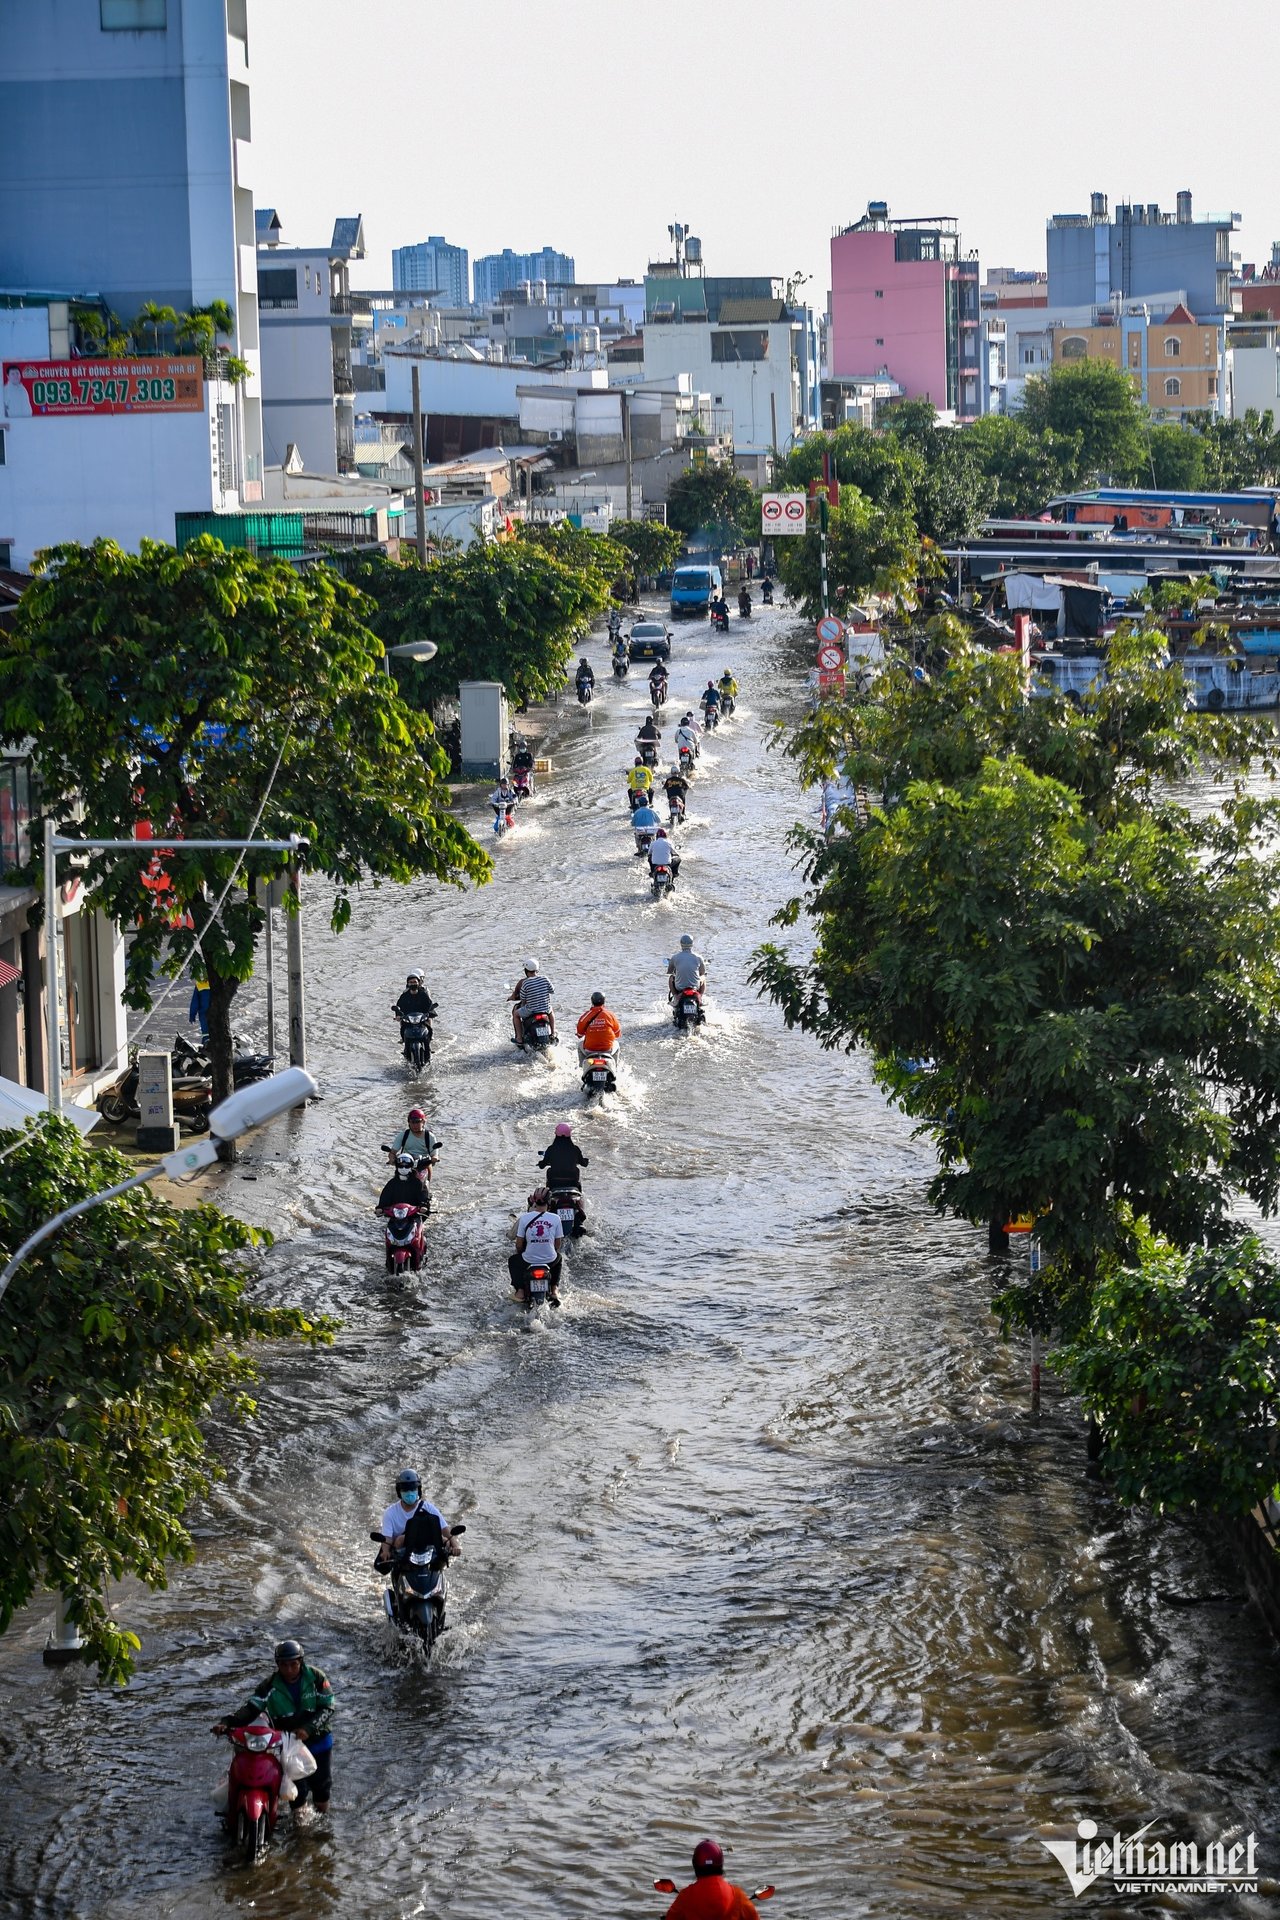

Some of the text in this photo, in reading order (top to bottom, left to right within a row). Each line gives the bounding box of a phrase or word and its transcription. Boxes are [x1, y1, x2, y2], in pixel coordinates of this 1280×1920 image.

[155, 364, 160, 375] 7
[33, 377, 176, 405] 093.7347.303
[635, 770, 647, 779] be
